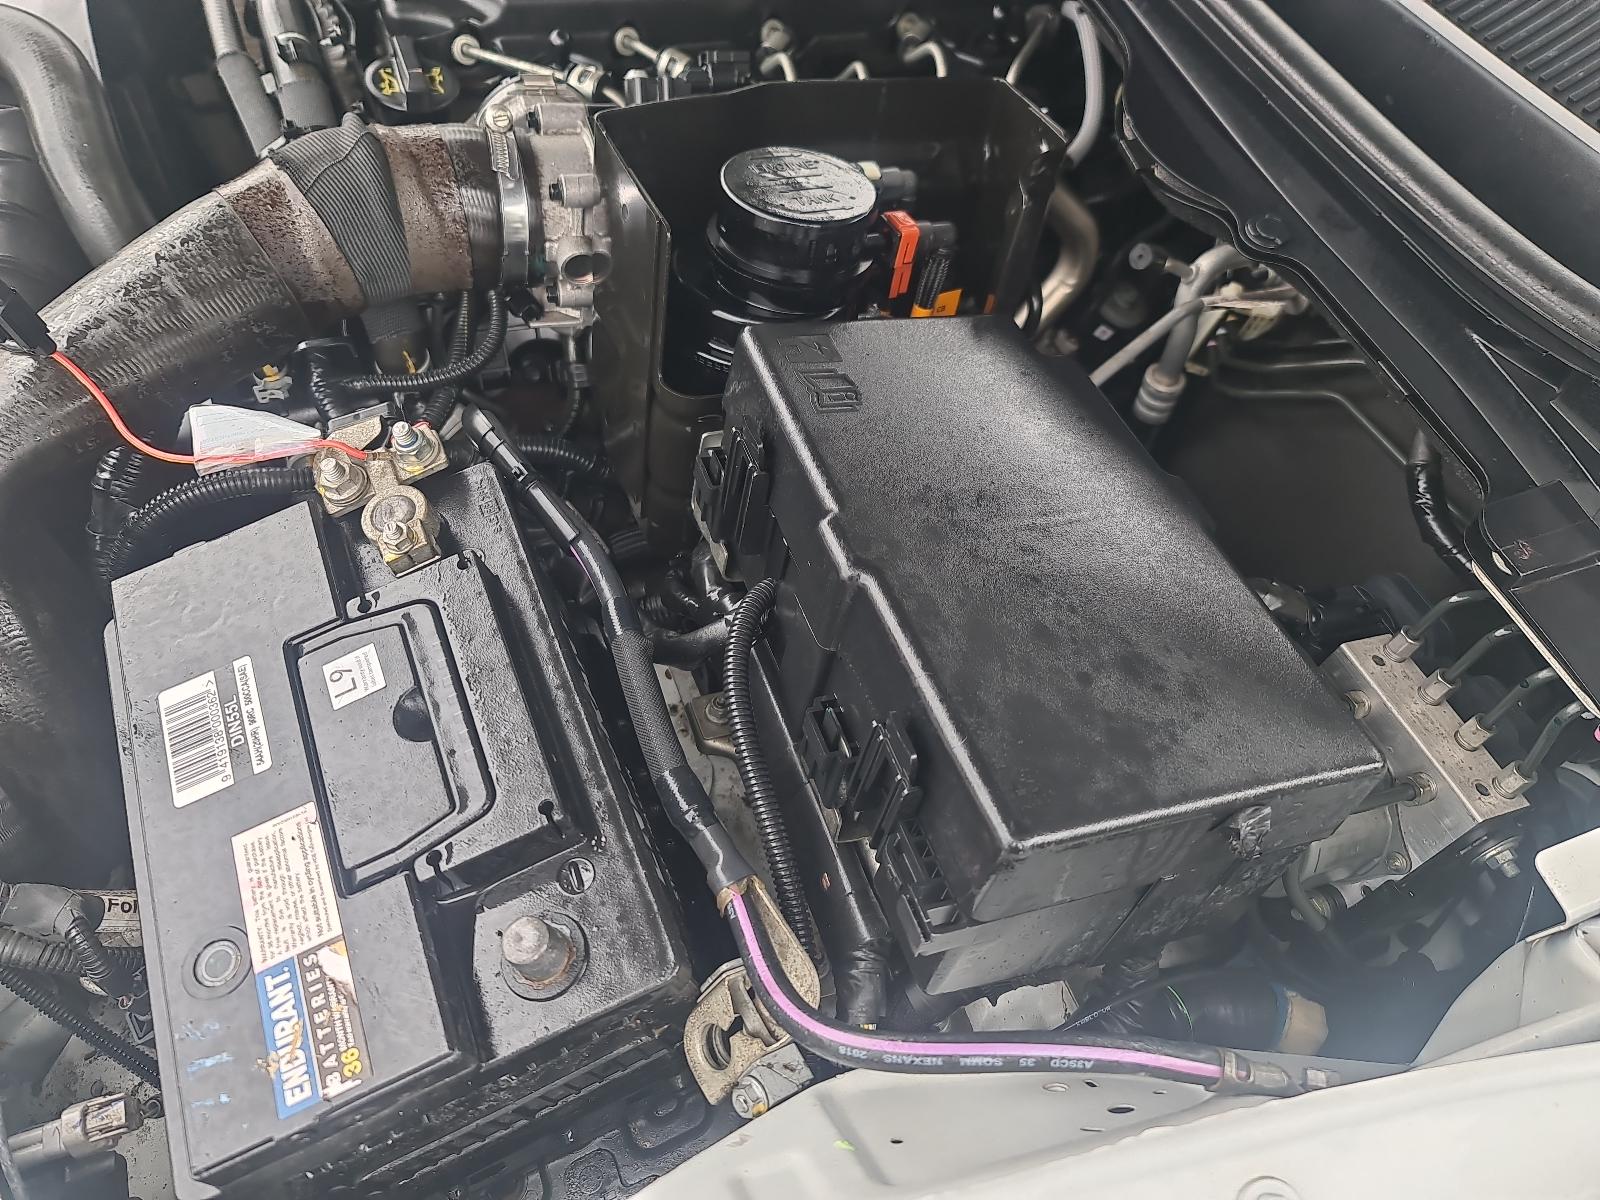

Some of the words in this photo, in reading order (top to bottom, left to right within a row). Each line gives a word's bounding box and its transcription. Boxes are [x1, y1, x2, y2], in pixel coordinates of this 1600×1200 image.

[206, 689, 222, 728] 000362
[222, 693, 245, 747] DIN55L
[212, 729, 229, 769] 419138
[220, 772, 231, 783] 9
[301, 951, 341, 1088] BATTERIES
[341, 1047, 362, 1079] 36
[881, 1052, 943, 1066] NEXANS
